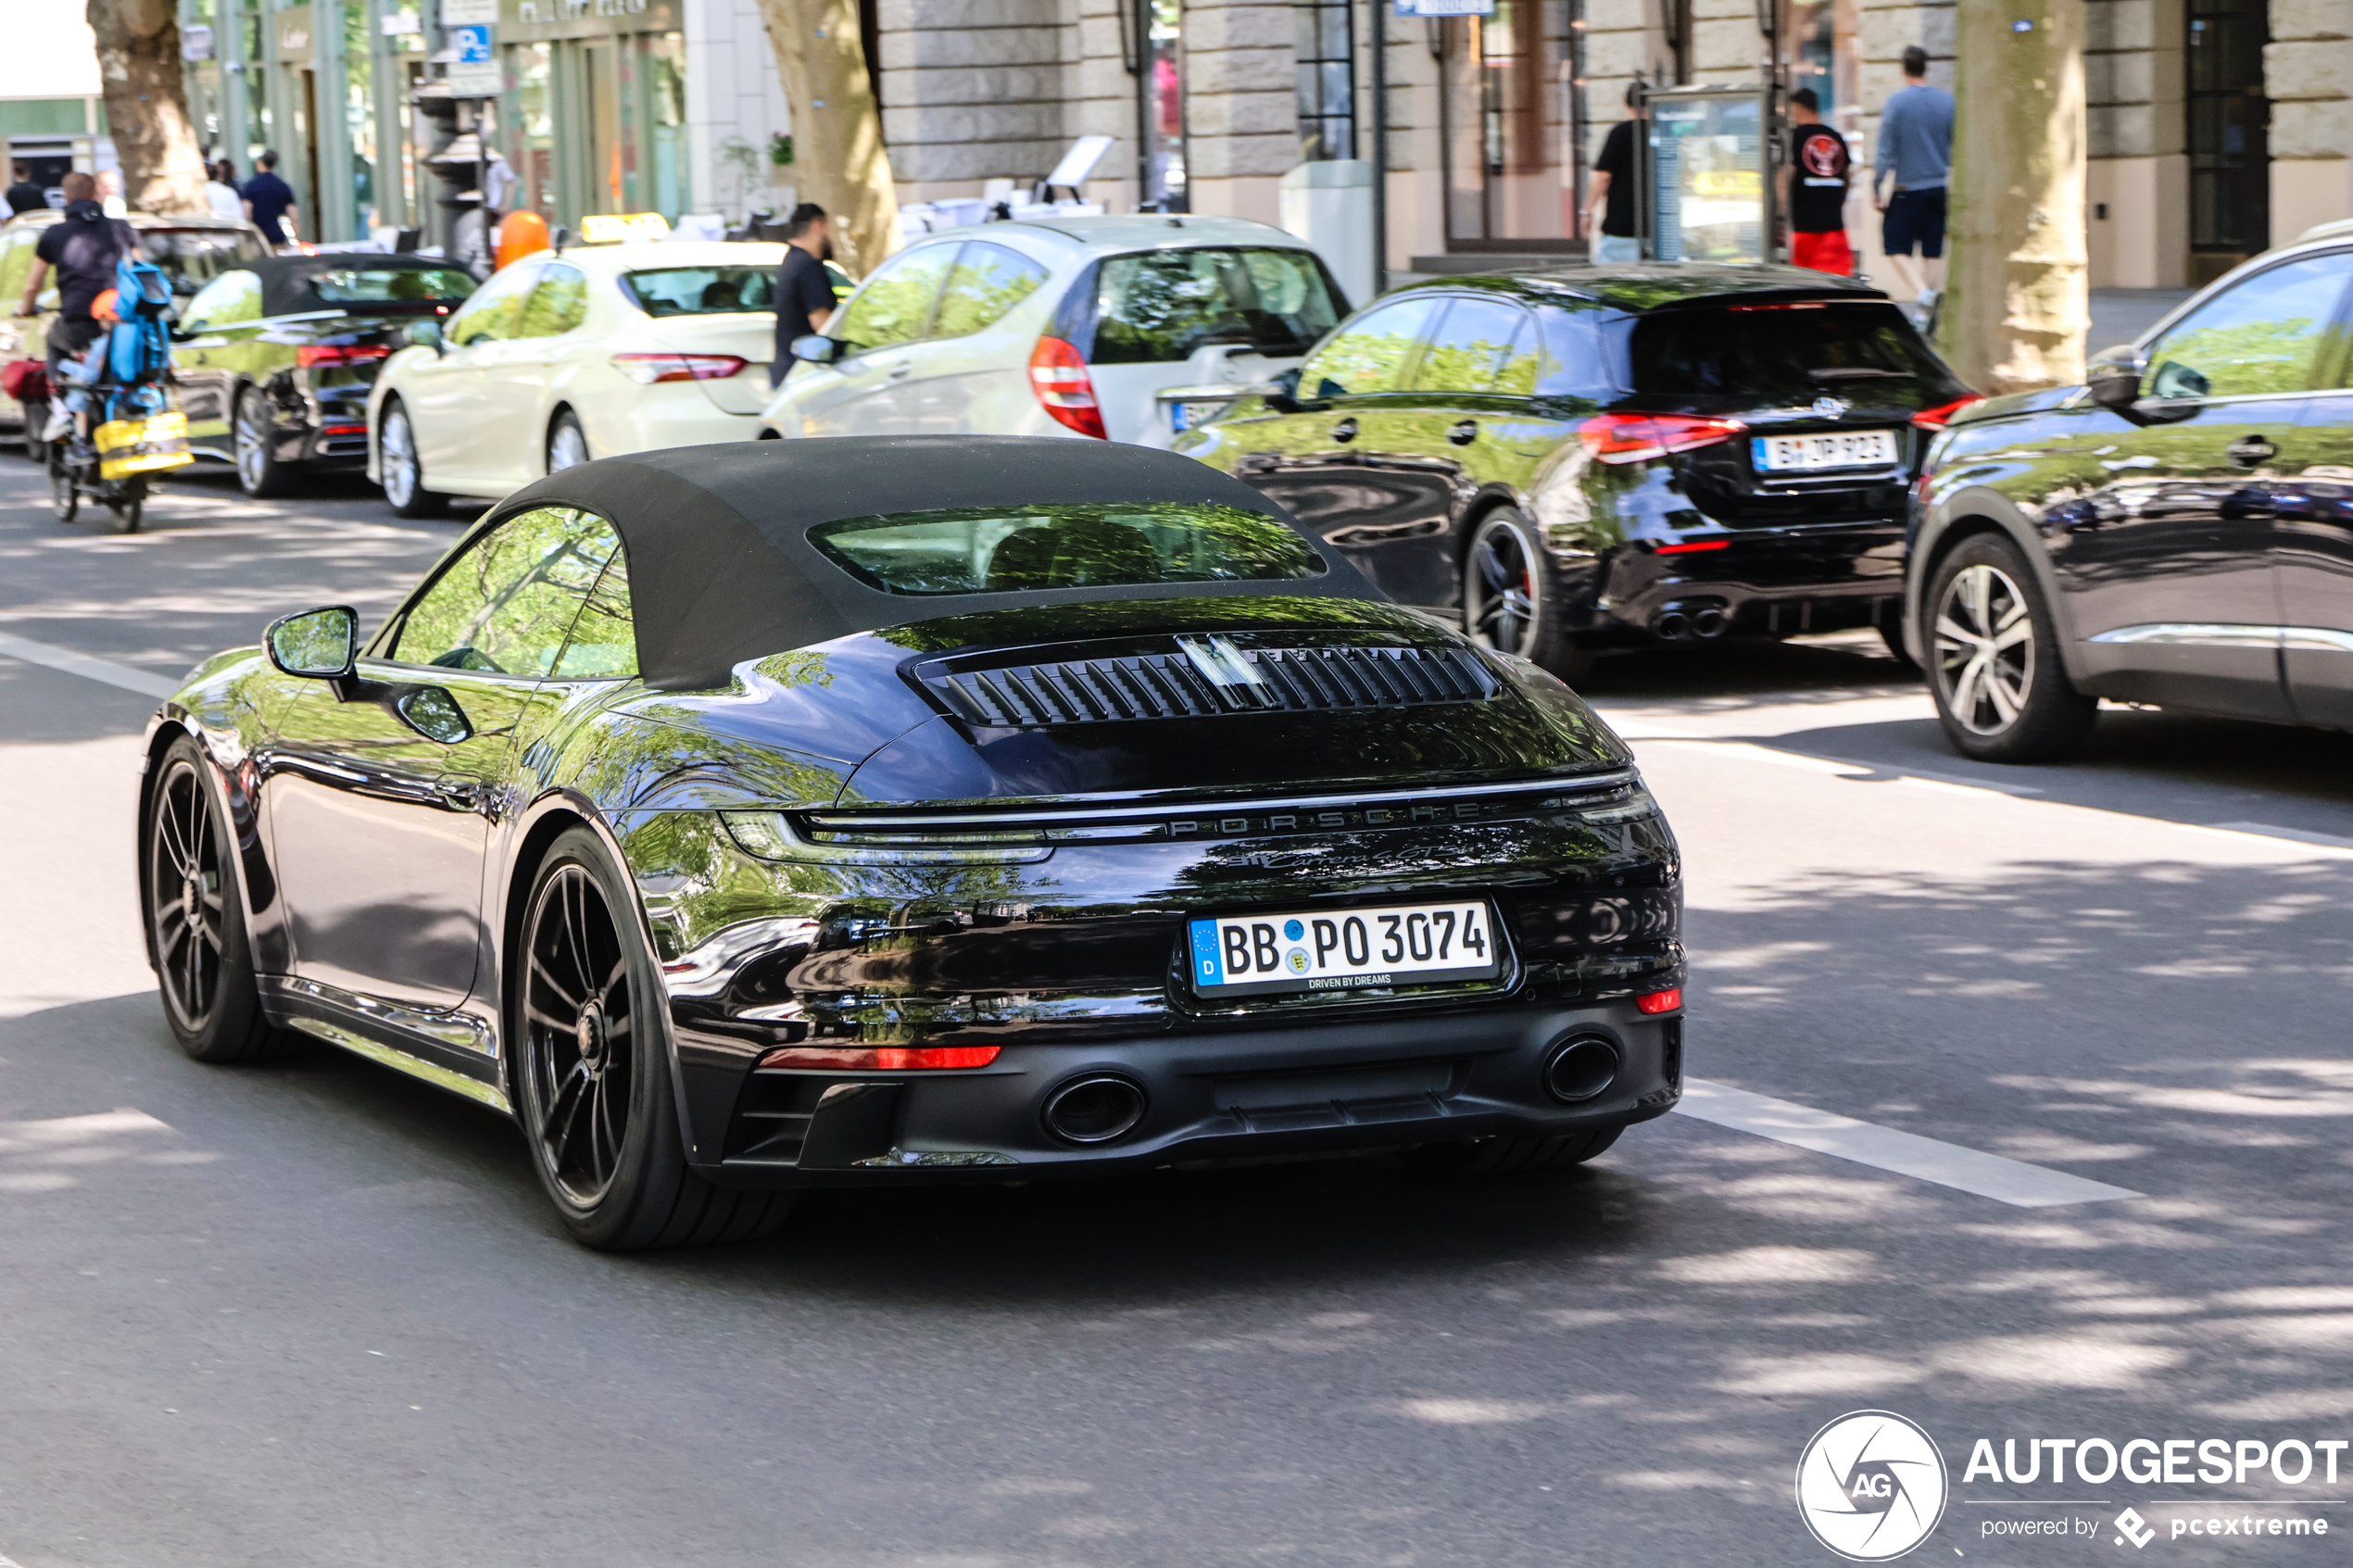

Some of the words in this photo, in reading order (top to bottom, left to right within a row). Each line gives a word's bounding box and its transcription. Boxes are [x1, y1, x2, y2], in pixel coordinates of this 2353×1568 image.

[1778, 441, 1792, 463] B
[1169, 803, 1479, 836] PORSCHE
[1264, 853, 1369, 869] Carrera
[1396, 845, 1459, 859] GTS
[1223, 923, 1280, 975] BB
[1312, 916, 1369, 968] PO
[1378, 909, 1485, 963] 3074
[1203, 960, 1214, 975] D
[1308, 976, 1342, 989] DRIVEN
[1342, 976, 1354, 987] BY
[1354, 974, 1391, 986] DREAMS
